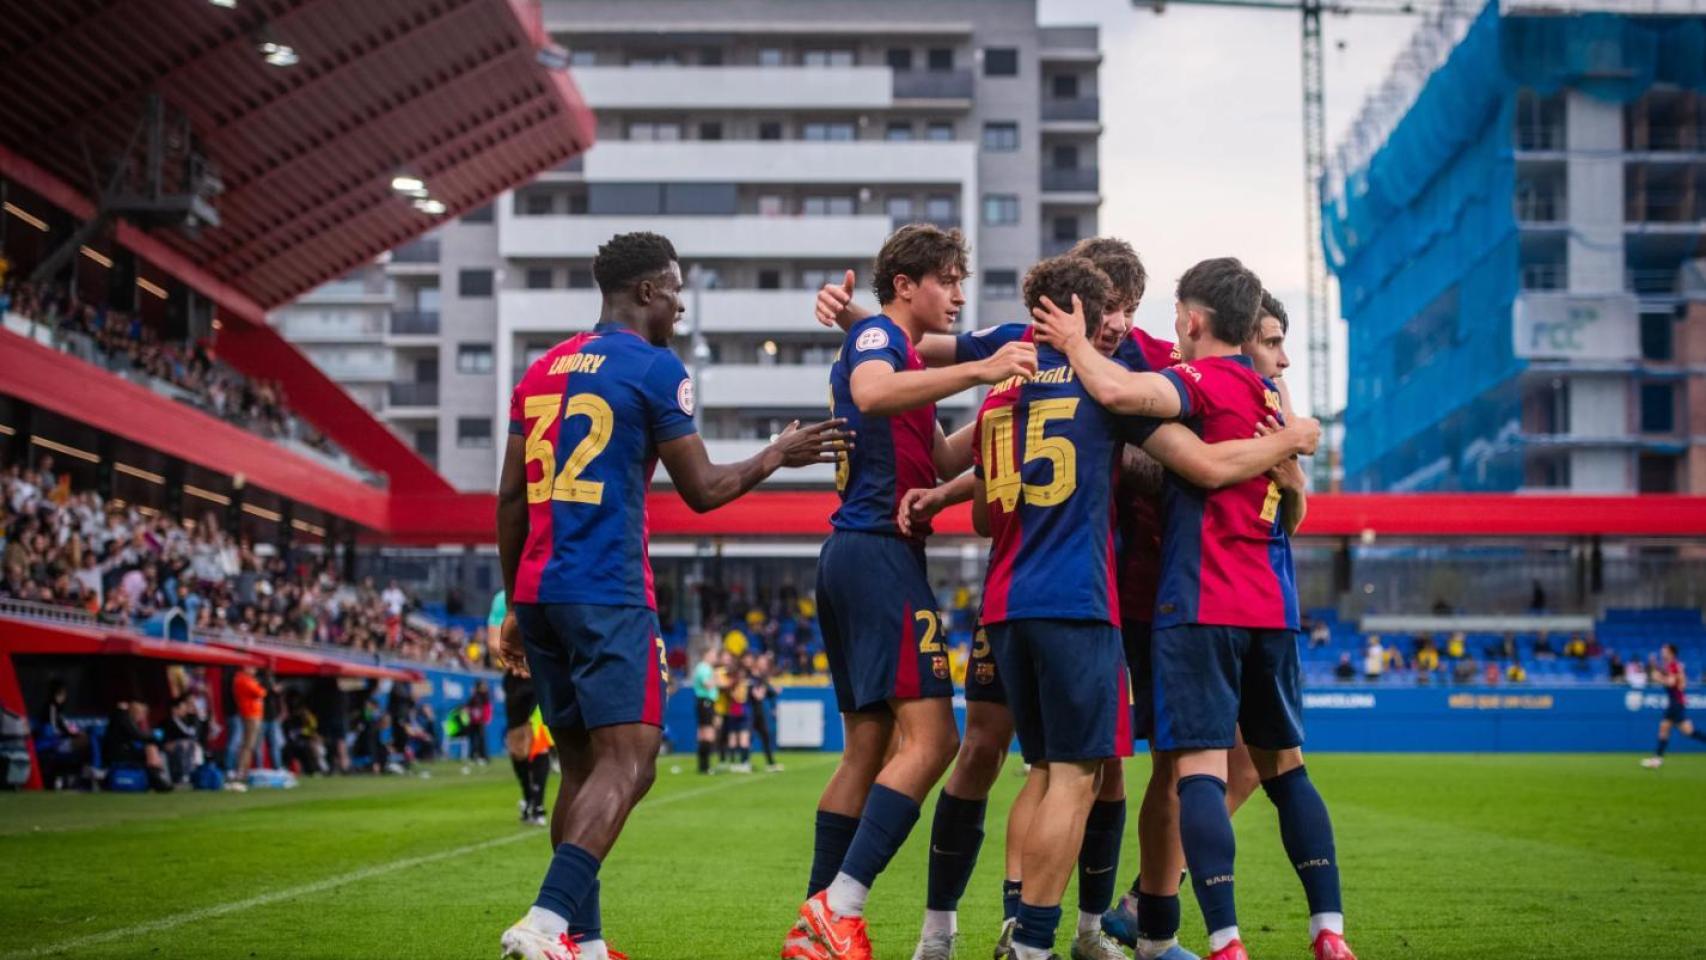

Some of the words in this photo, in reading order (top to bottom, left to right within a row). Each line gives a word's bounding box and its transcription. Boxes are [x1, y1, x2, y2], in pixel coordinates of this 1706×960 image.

[547, 352, 606, 376] LANDRY
[524, 392, 614, 505] 32
[981, 397, 1081, 514] 45
[915, 609, 948, 653] 2
